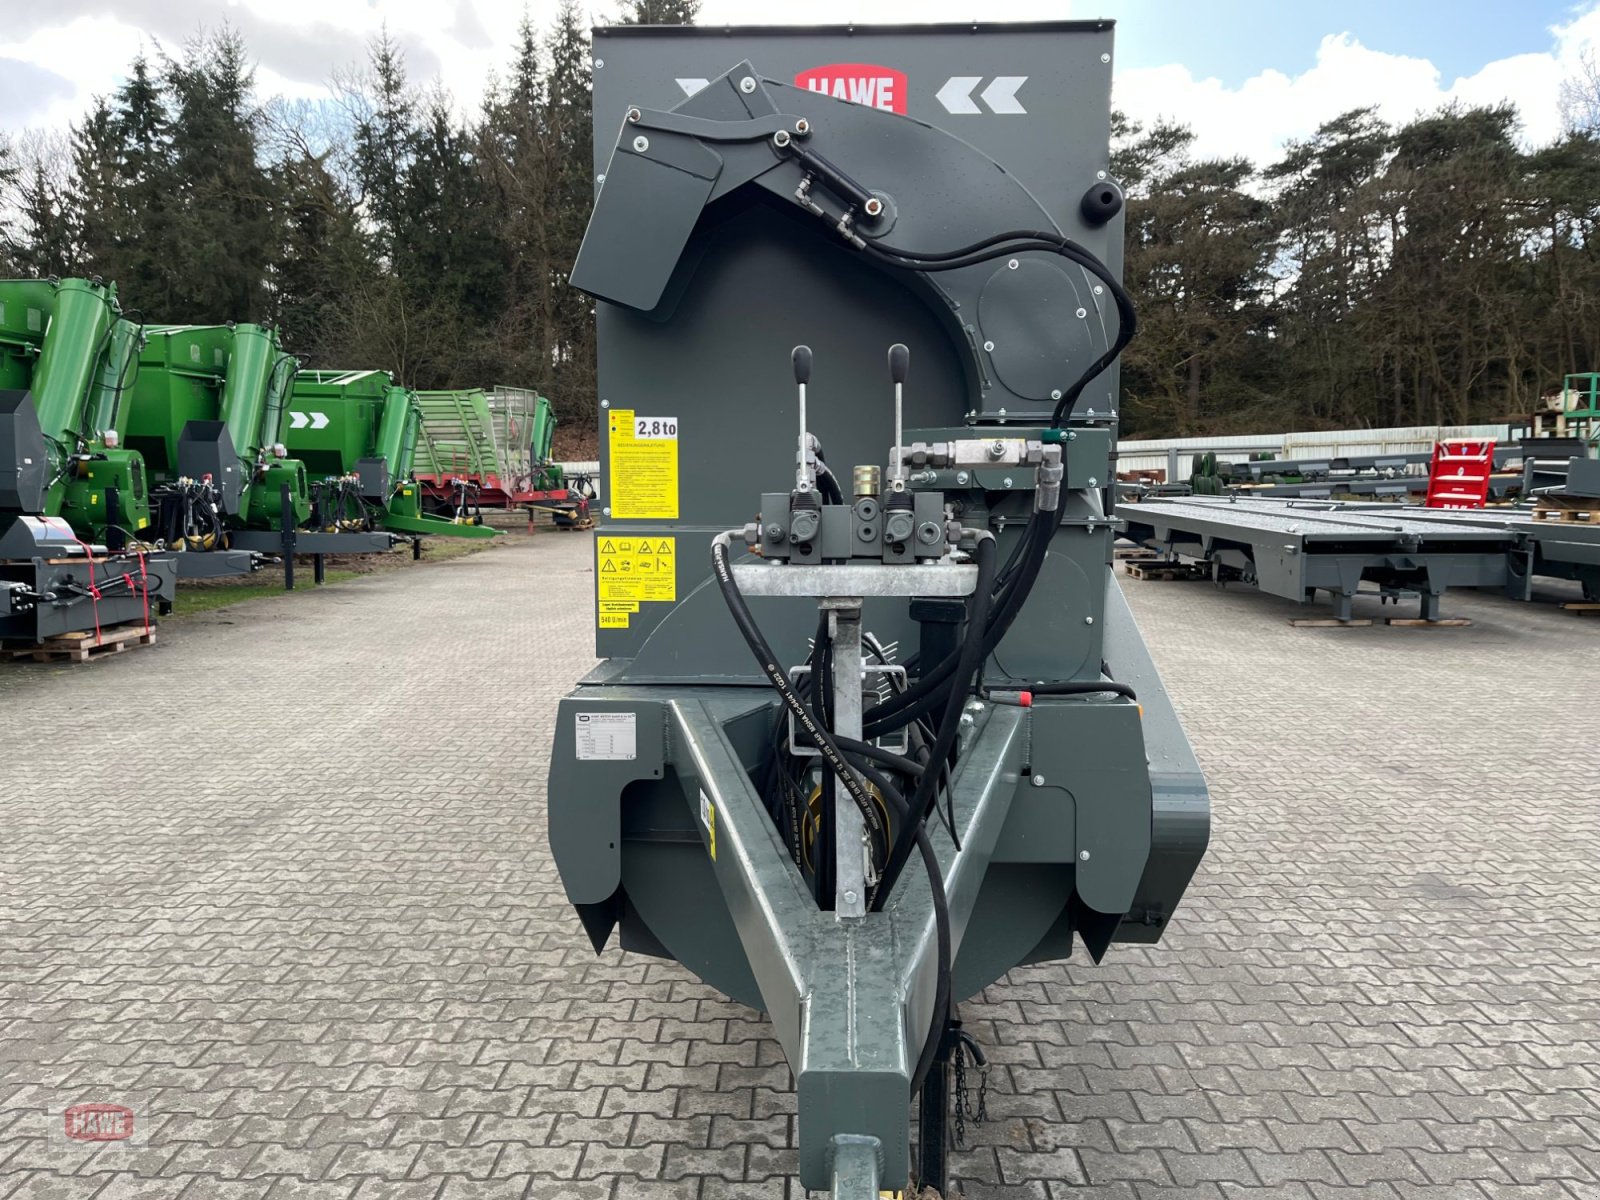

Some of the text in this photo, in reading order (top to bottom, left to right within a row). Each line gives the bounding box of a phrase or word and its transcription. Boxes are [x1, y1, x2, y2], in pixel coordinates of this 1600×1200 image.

[638, 421, 660, 437] 2,8
[662, 422, 676, 435] to
[601, 616, 611, 624] 540
[773, 672, 786, 690] 1Q22
[802, 714, 816, 732] MSHA
[814, 732, 826, 746] BAR
